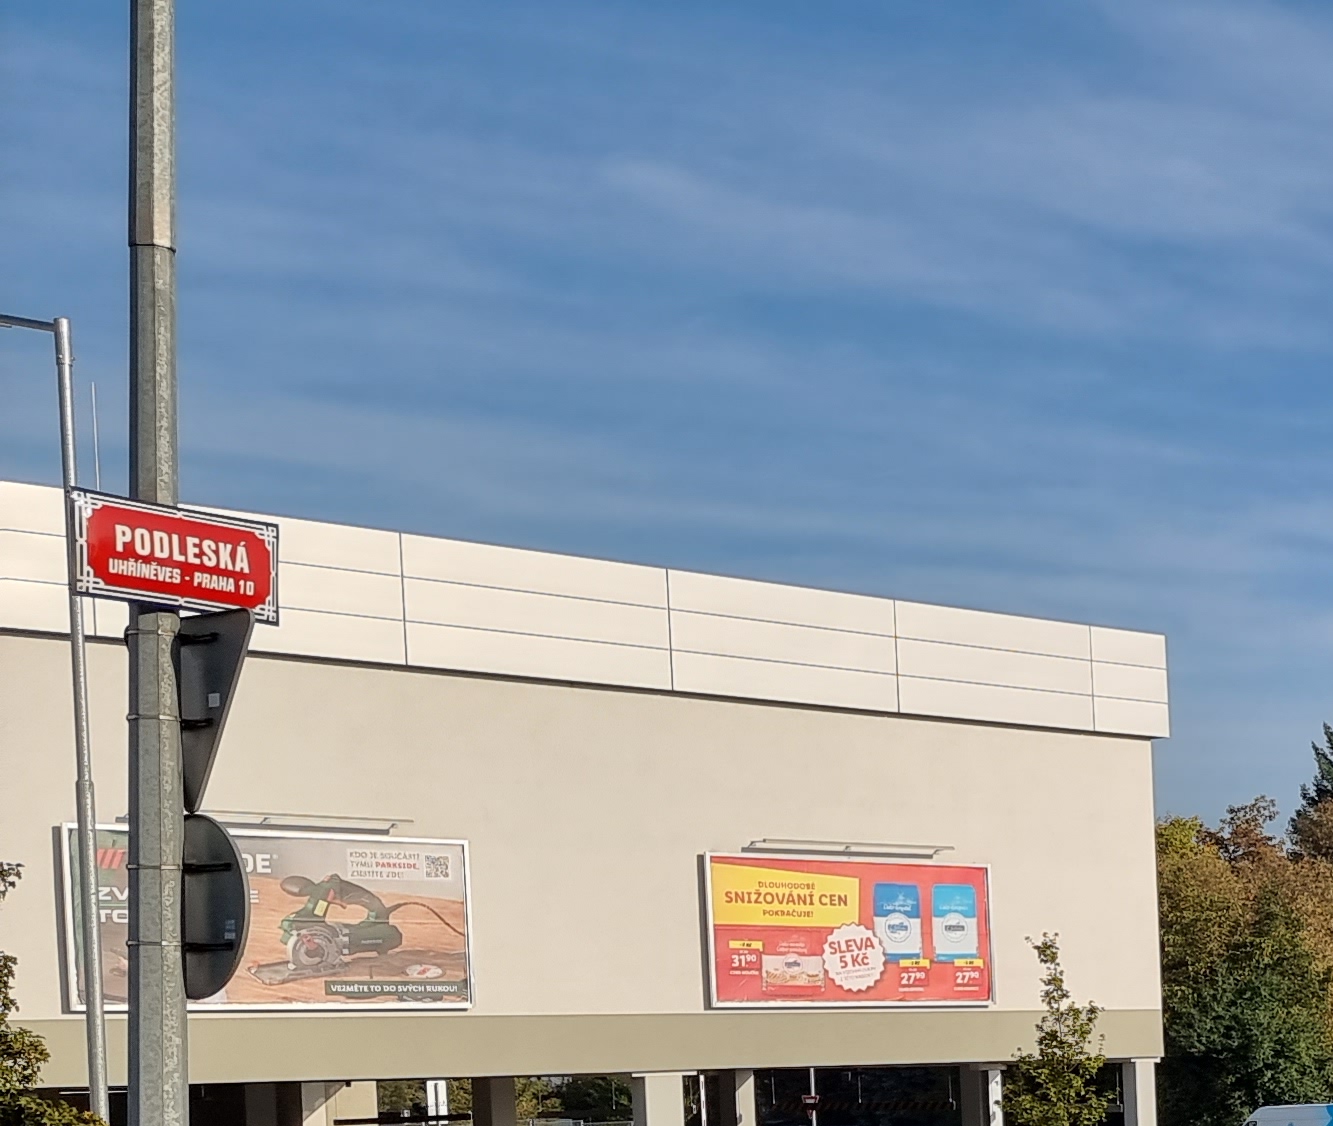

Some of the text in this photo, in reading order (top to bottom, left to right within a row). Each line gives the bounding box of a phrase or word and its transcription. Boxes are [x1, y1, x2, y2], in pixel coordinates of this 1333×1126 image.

[114, 524, 250, 574] PODLESKÁ
[108, 557, 181, 584] UHŘÍNĚVES
[193, 571, 235, 593] PRAHA
[238, 579, 254, 596] 10
[724, 889, 848, 907] SNIŽOVÁNÍ CEN
[828, 936, 876, 956] SLEVA
[839, 951, 870, 969] 5 Kč
[370, 984, 382, 993] TO
[383, 984, 397, 993] DO
